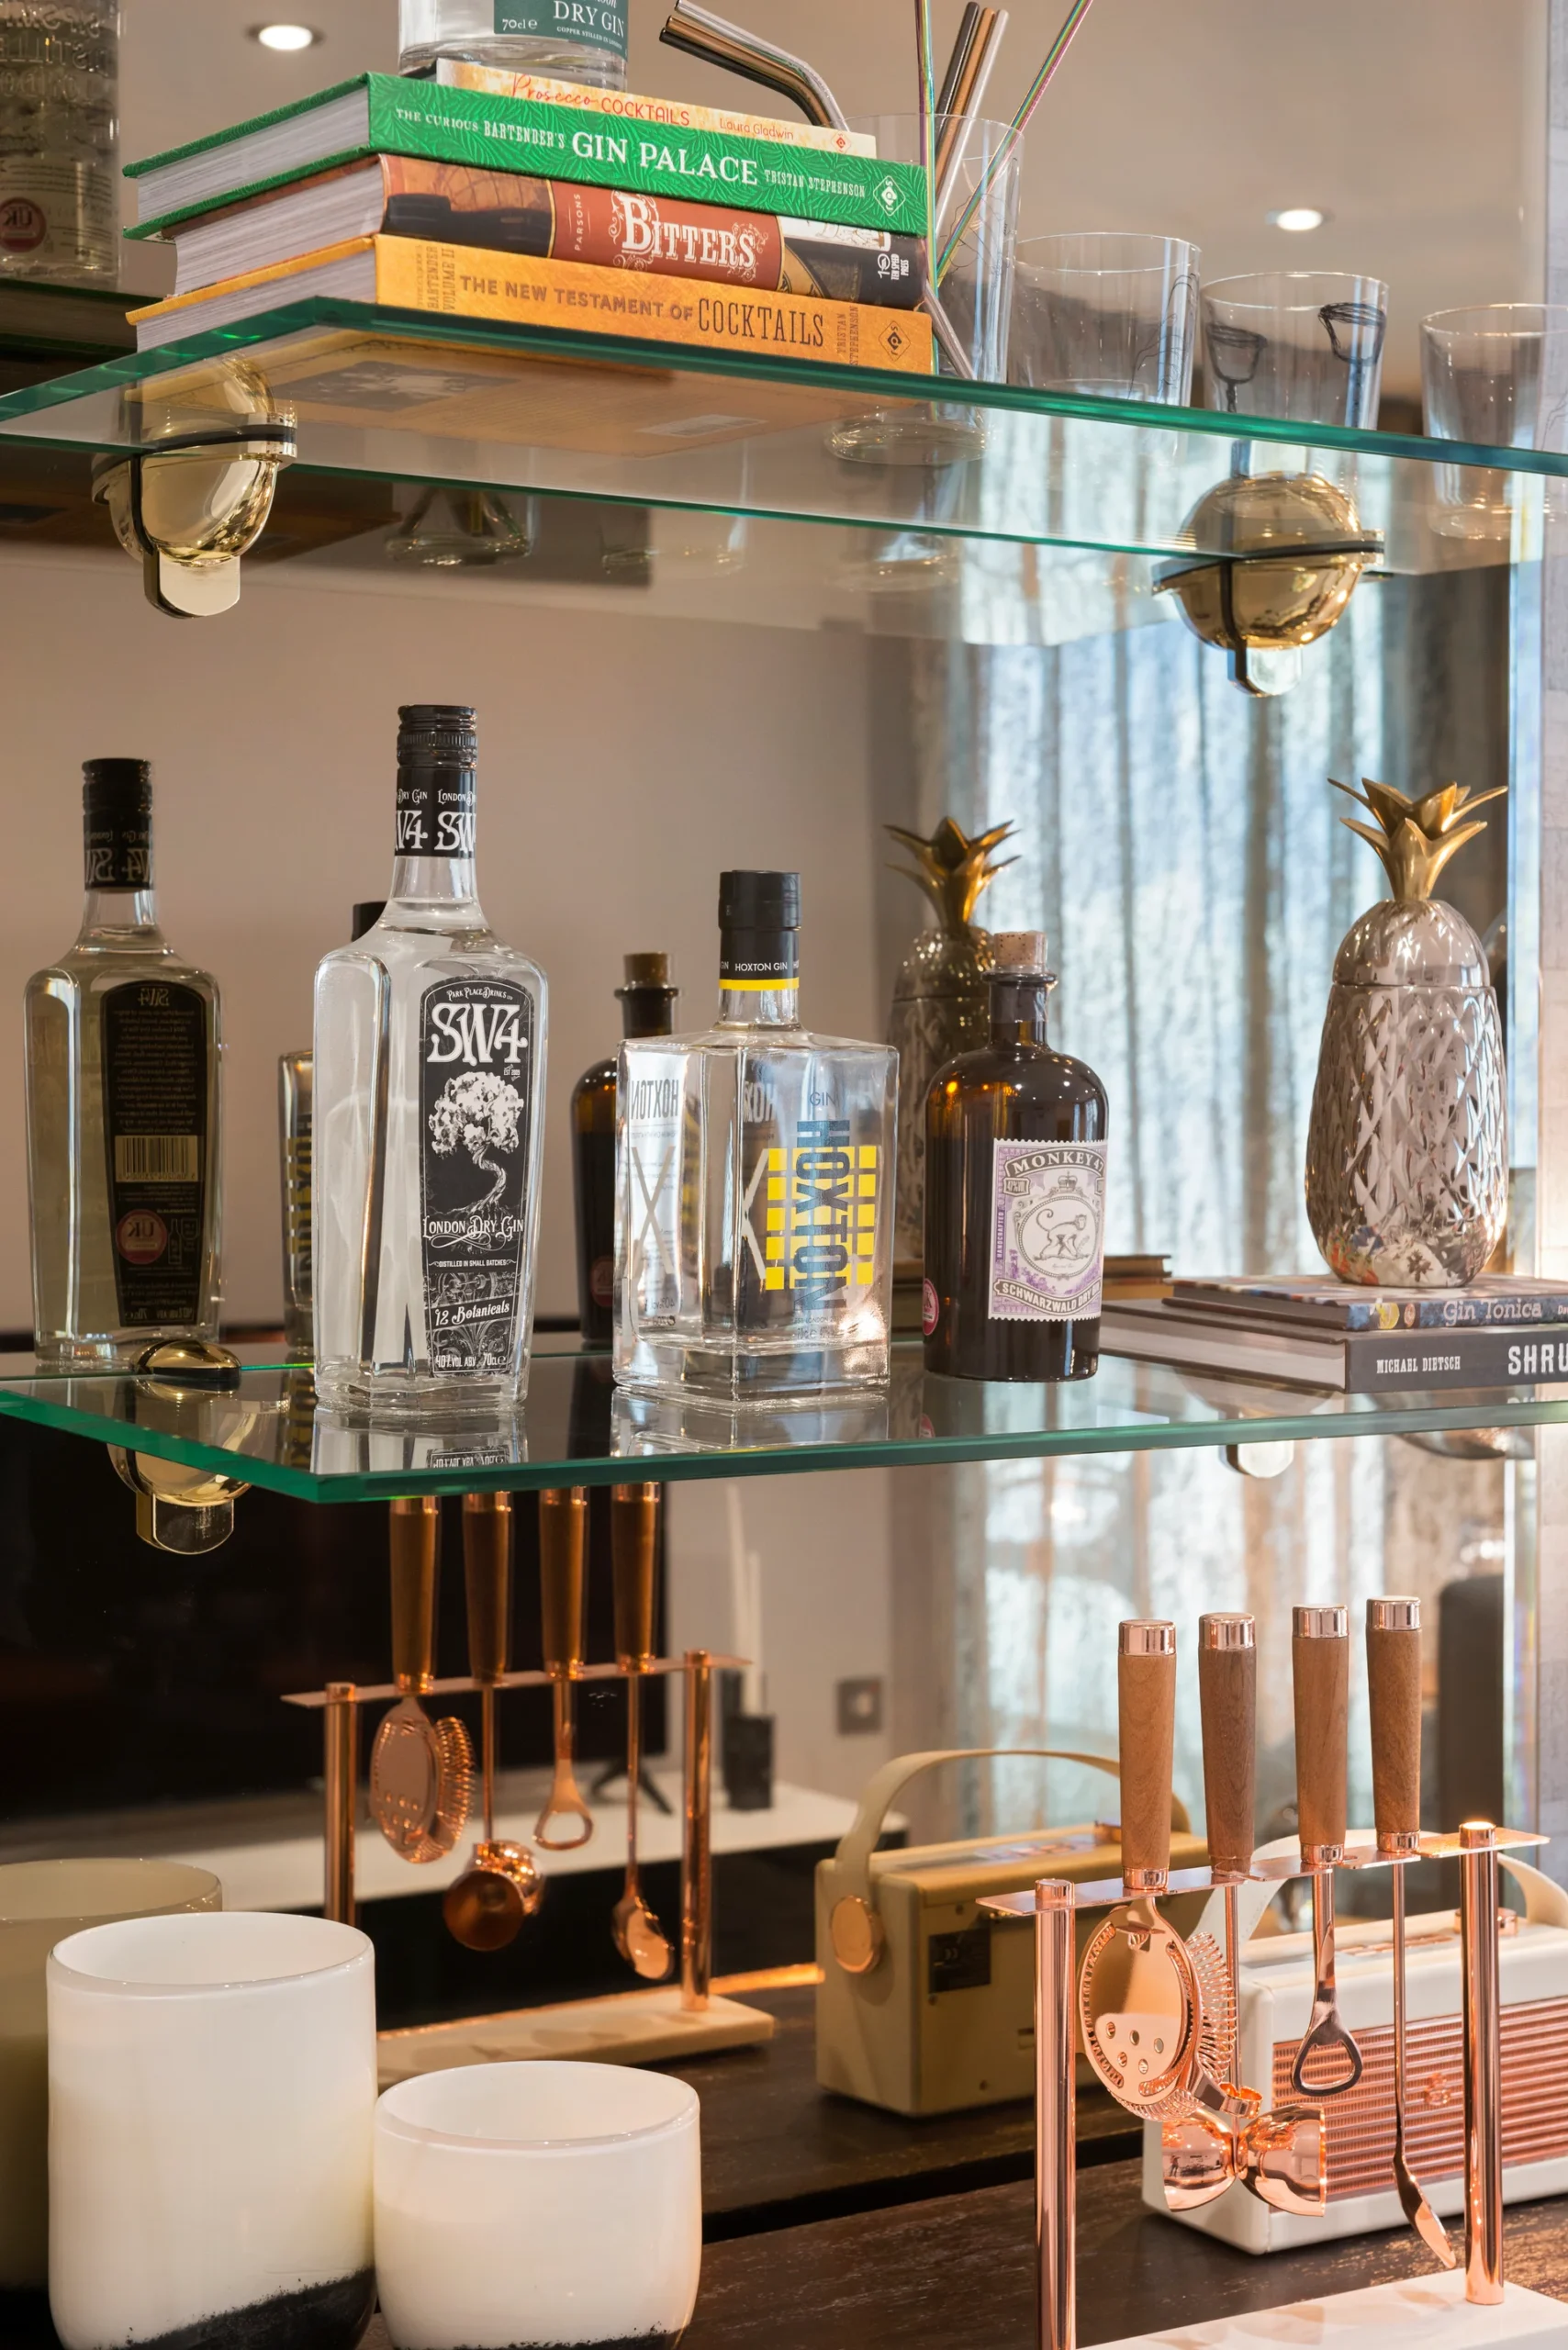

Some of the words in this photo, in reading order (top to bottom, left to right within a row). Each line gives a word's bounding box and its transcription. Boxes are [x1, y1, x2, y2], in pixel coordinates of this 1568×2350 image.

[502, 18, 526, 30] 70cl
[553, 1, 598, 26] DRY
[601, 11, 624, 39] GIN
[556, 26, 581, 36] COPPER
[582, 31, 603, 42] STILLED
[511, 73, 597, 106] Prosecco
[601, 97, 689, 126] COCKTAILS
[720, 118, 750, 134] Laura
[753, 122, 794, 140] Gladwin
[396, 108, 420, 122] THE
[426, 114, 478, 131] CURIOUS
[483, 120, 566, 149] BARTENDER'S
[572, 131, 628, 163] GIN
[639, 142, 757, 185] PALACE
[765, 170, 804, 188] TRISTAN
[808, 177, 866, 198] STEPHENSON
[574, 194, 582, 252] PARSONS
[890, 253, 900, 270] SPEED
[890, 269, 900, 281] TEN
[901, 259, 909, 276] PRESS
[426, 246, 439, 309] BARTENDER
[442, 262, 456, 310] VOLUME
[460, 276, 498, 295] THE
[506, 283, 548, 301] NEW
[554, 288, 664, 318] TESTAMENT
[670, 305, 693, 321] OF
[699, 297, 823, 347] COCKTAILS
[836, 312, 846, 353] TRISTAN
[849, 306, 858, 365] STEPHENSON
[734, 962, 771, 971] HOXTON
[773, 962, 788, 970] GIN
[446, 990, 464, 1002] PARK
[464, 987, 483, 999] PLACE
[482, 987, 507, 999] DRINKS
[426, 1002, 528, 1067] SW4
[810, 1091, 838, 1106] GIN
[1013, 1151, 1092, 1175] MONKEY
[422, 1215, 466, 1240] LONDON
[466, 1215, 497, 1239] DRY
[495, 1215, 524, 1241] GIN
[793, 1119, 851, 1311] HOXTON
[996, 1211, 1004, 1259] HANDCRAFTED
[1002, 1282, 1078, 1313] SCHWARZWALD
[1077, 1292, 1092, 1307] DRY
[1443, 1300, 1475, 1326] Gin
[1481, 1298, 1542, 1319] Tonica
[434, 1308, 449, 1326] 12
[451, 1300, 510, 1326] Botanicals
[464, 1356, 476, 1368] ABV
[1376, 1358, 1418, 1374] MICHAEL
[1422, 1356, 1462, 1371] DIETSCH
